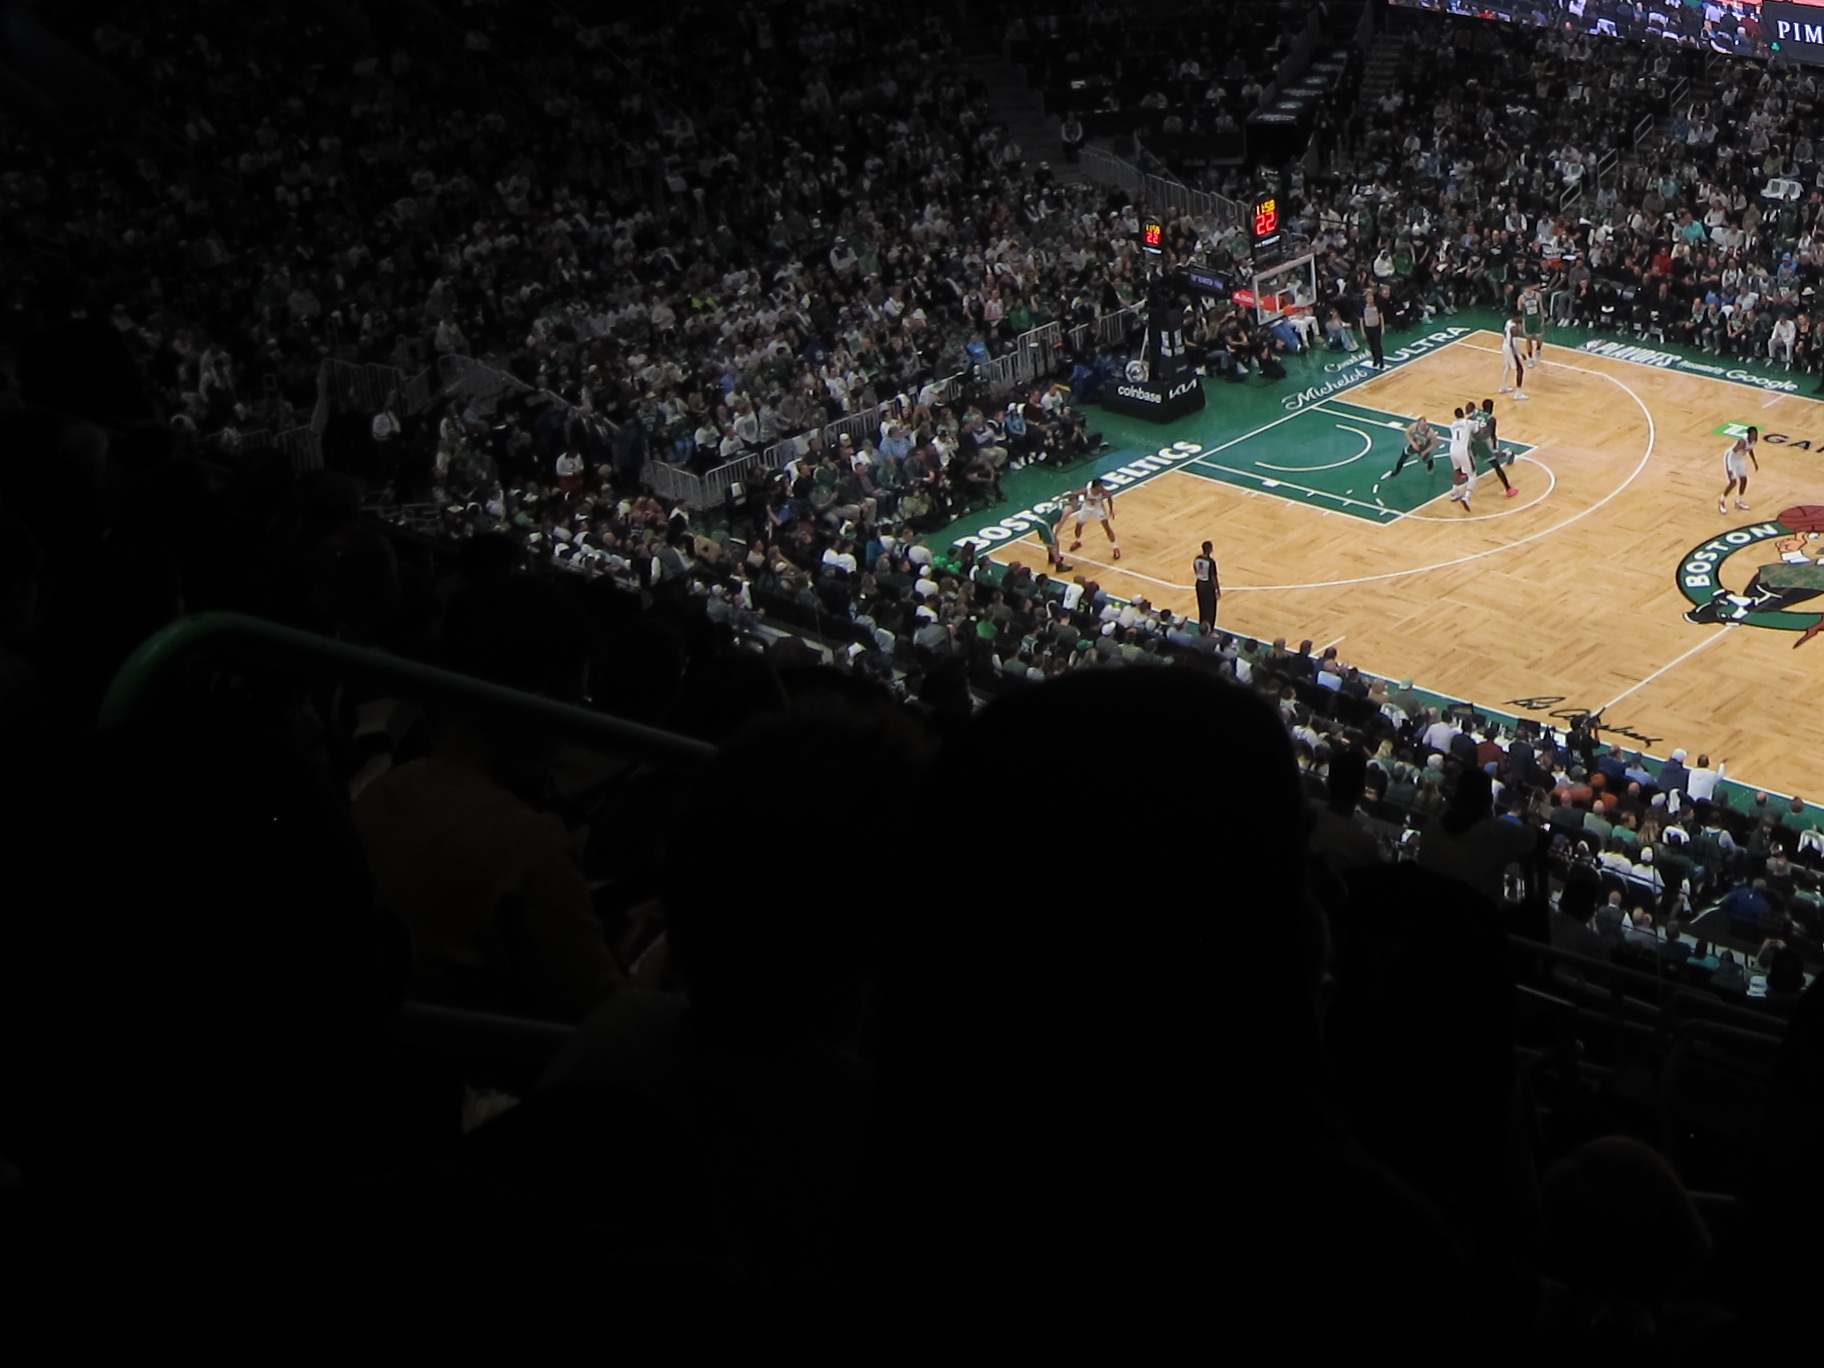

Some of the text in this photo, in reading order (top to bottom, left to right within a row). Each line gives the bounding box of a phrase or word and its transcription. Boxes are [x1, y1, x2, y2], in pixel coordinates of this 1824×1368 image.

[1146, 232, 1161, 245] 22
[1256, 212, 1277, 236] 22
[1383, 326, 1471, 362] ULTRA
[1594, 341, 1799, 392] PLAYOFFS Google
[1117, 385, 1162, 404] coinbase
[1281, 368, 1368, 411] Michelob
[1100, 440, 1204, 492] CELTICS
[1684, 523, 1779, 589] BOSTON
